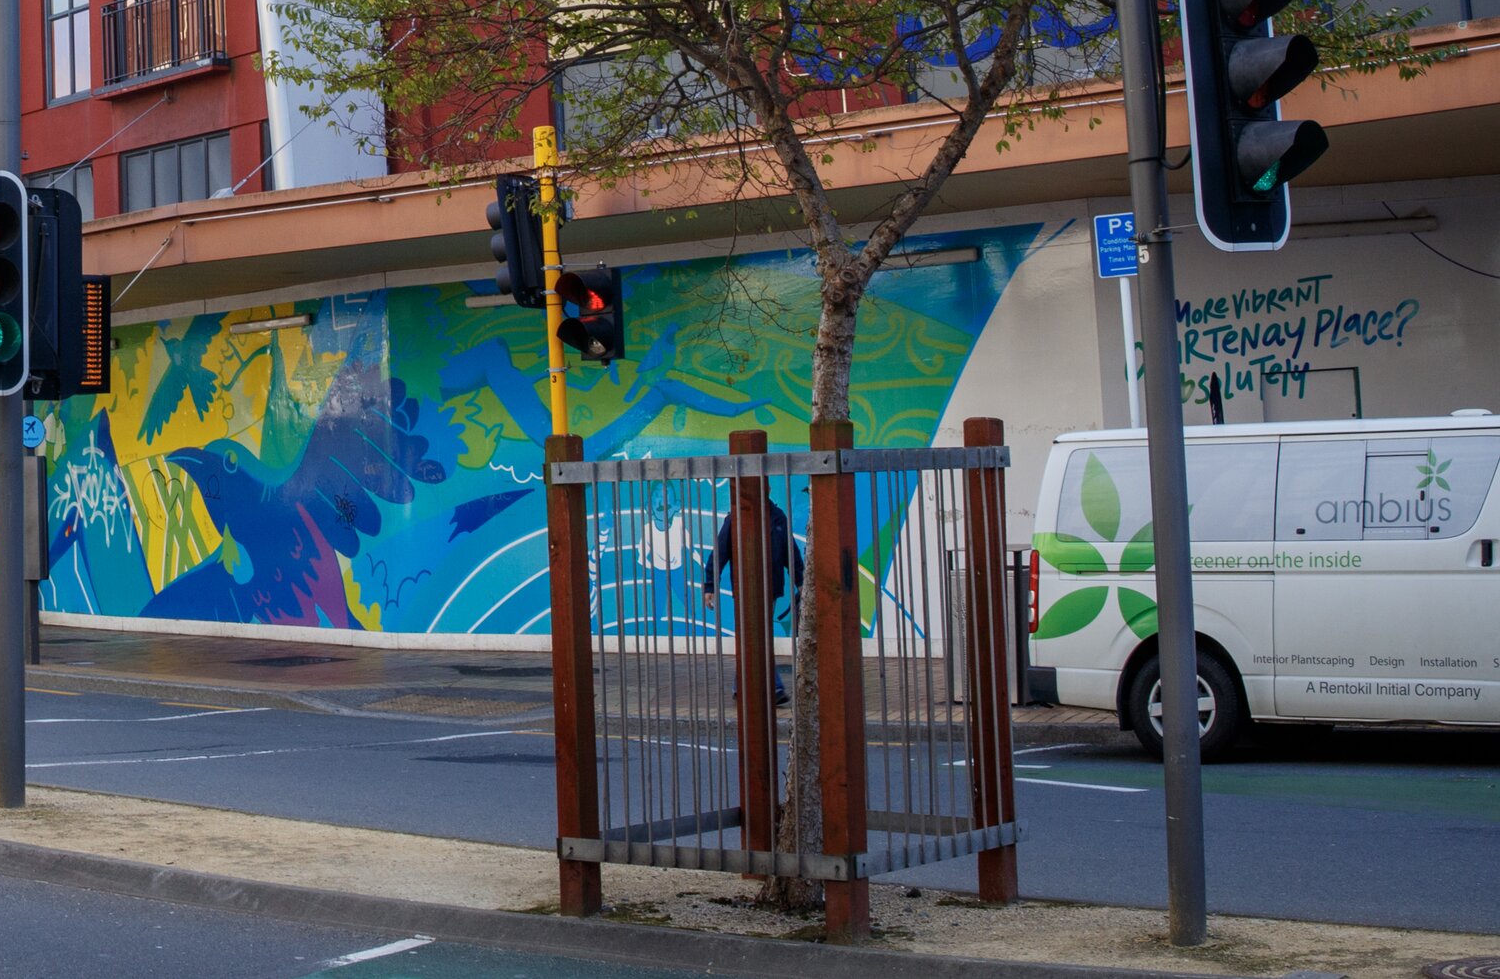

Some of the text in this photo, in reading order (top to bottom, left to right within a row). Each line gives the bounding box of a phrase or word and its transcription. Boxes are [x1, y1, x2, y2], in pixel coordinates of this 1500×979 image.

[1108, 218, 1122, 235] P
[1138, 245, 1150, 264] 5
[1315, 492, 1453, 525] ambius
[1247, 555, 1270, 569] on
[1274, 551, 1304, 569] the
[1308, 550, 1363, 569] inside
[1252, 654, 1289, 665] Interior
[1290, 654, 1355, 668] Plantscaping
[1369, 655, 1405, 669] Design
[1420, 657, 1478, 668] Installation
[1305, 680, 1481, 700] A Rentokil Initial Company
